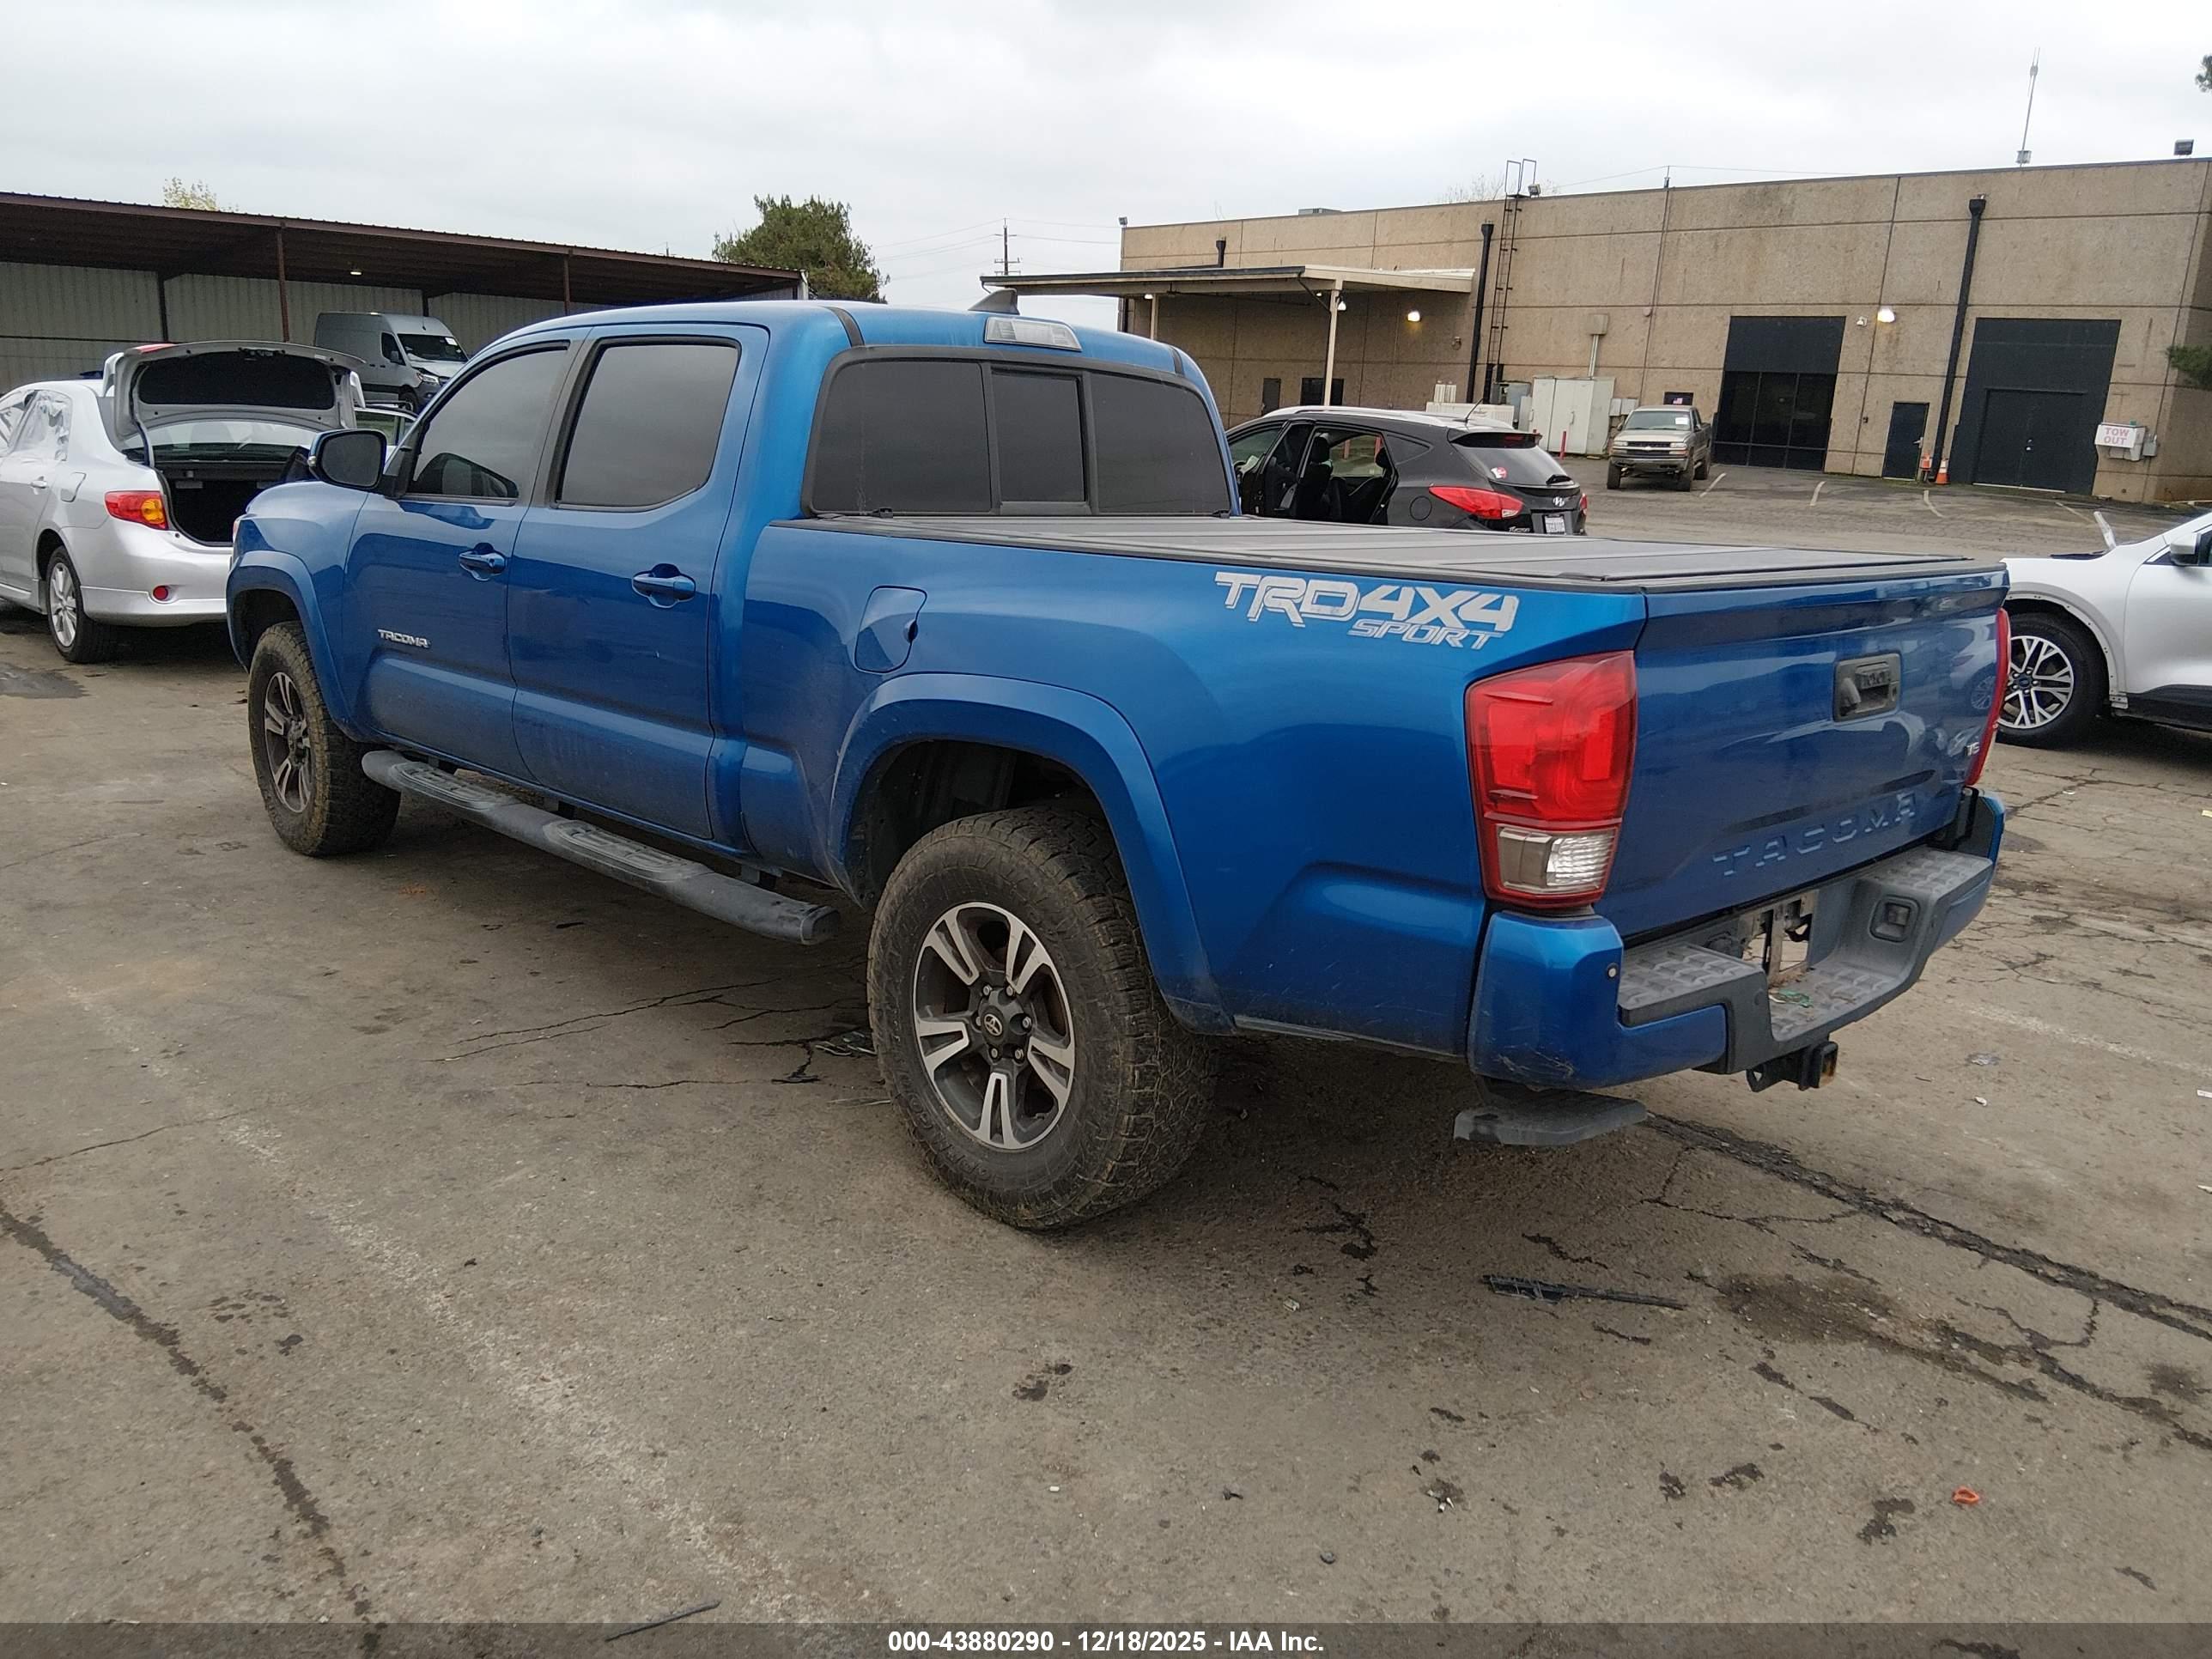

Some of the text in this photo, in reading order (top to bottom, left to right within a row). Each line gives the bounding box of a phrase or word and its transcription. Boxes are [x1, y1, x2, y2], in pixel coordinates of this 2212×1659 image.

[2106, 428, 2130, 436] TOW
[1215, 571, 1360, 628] TRD
[378, 629, 430, 648] TACOMA
[1347, 618, 1504, 650] SPORT
[1713, 792, 1917, 875] TACOMA
